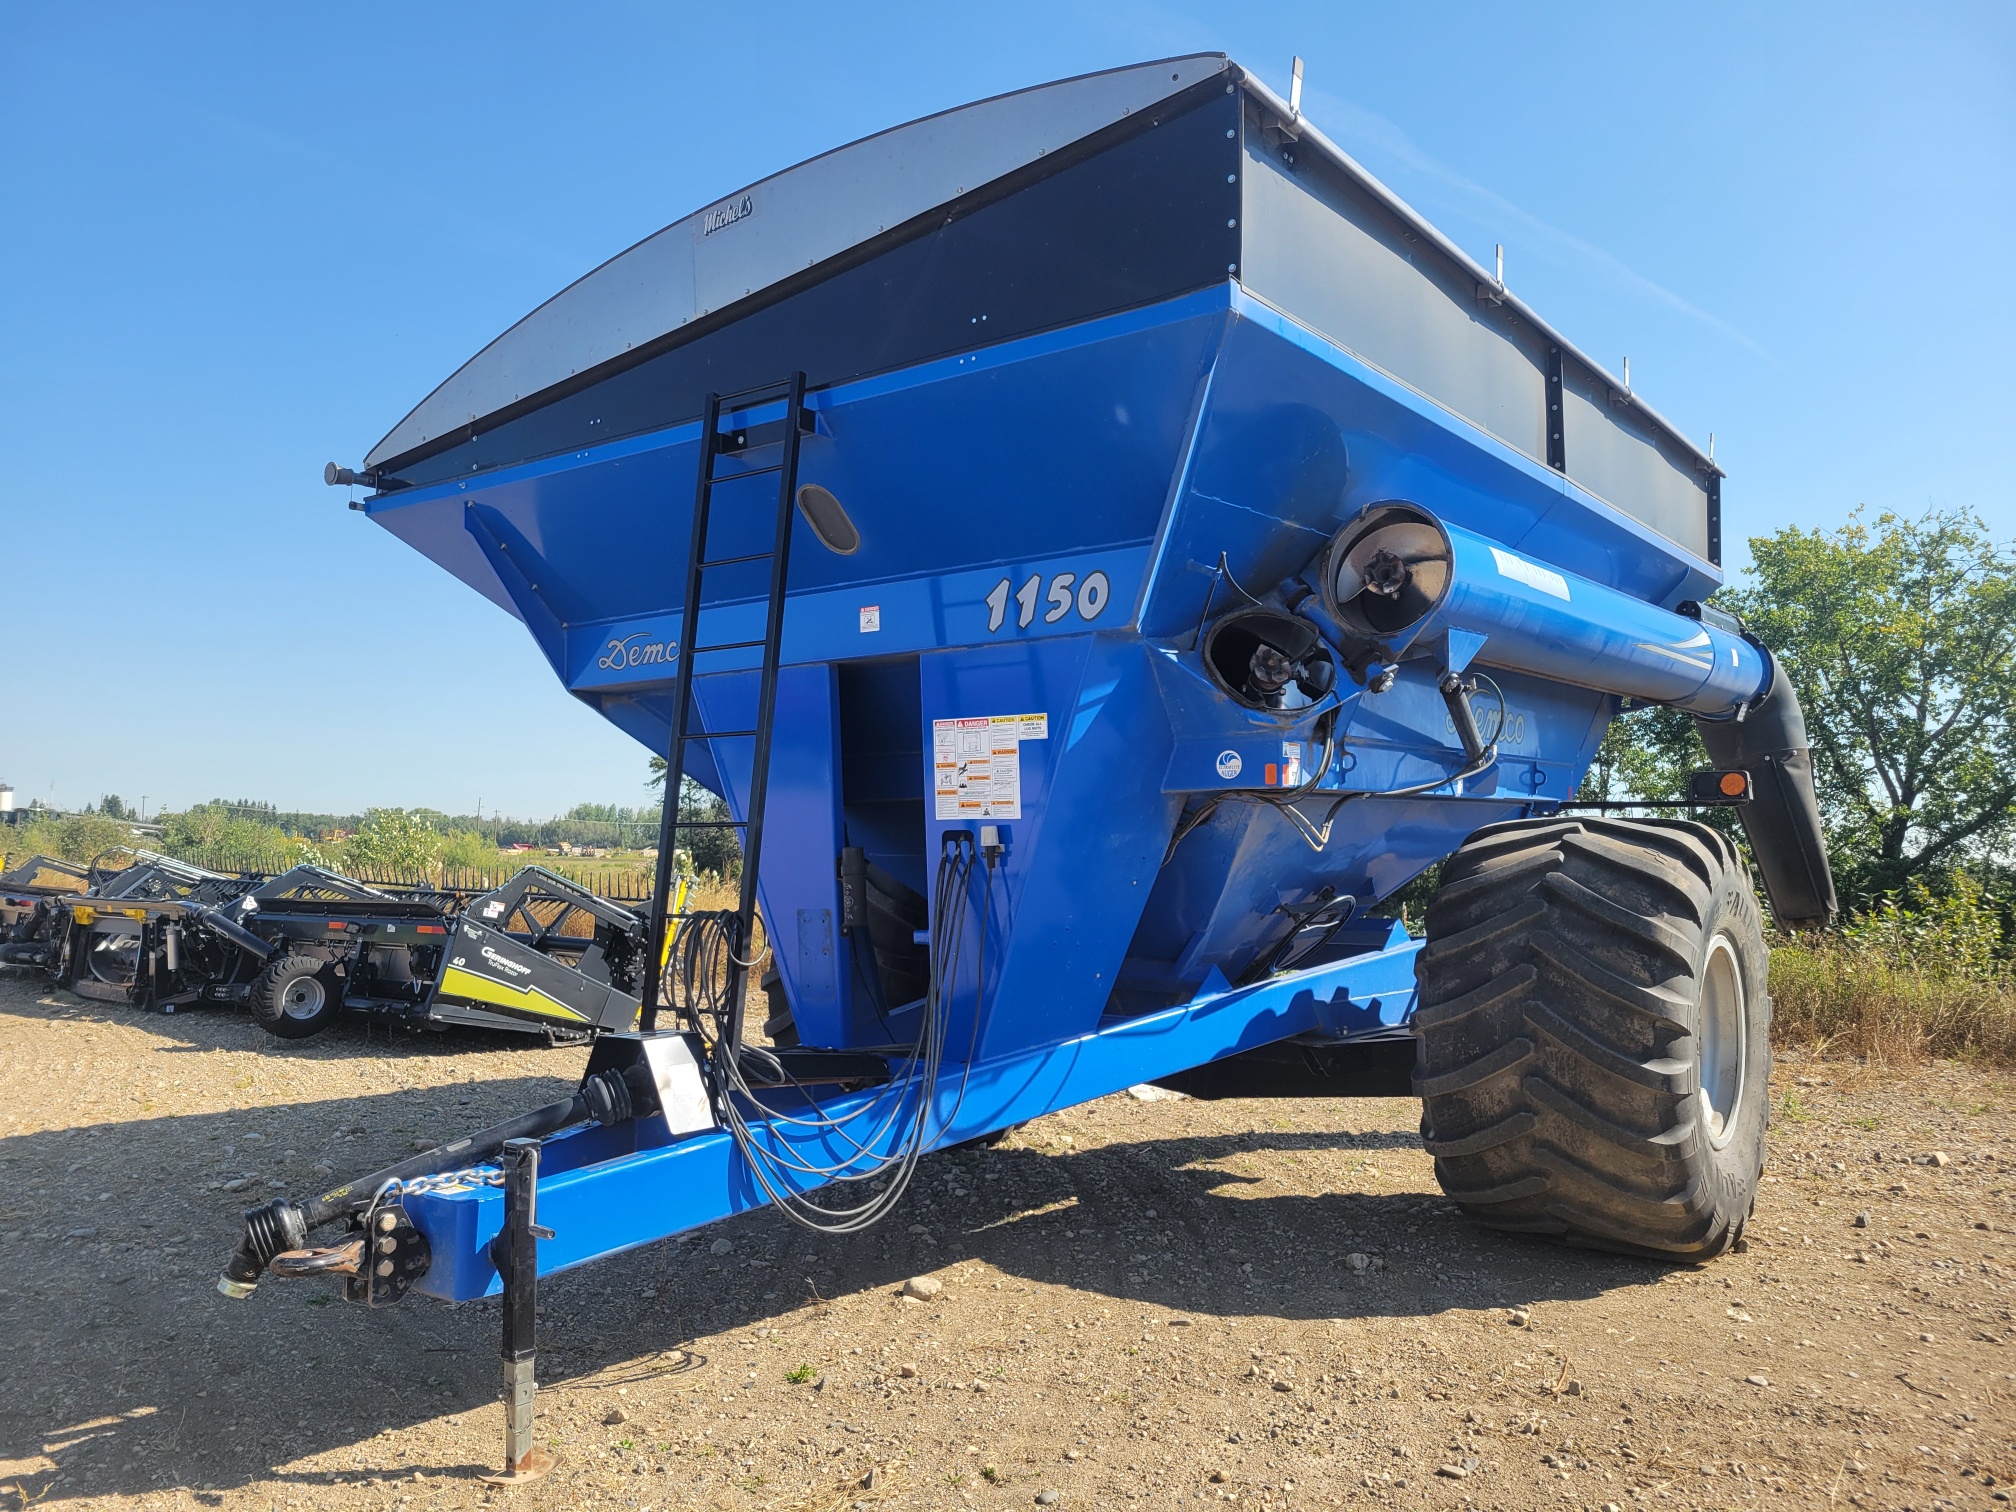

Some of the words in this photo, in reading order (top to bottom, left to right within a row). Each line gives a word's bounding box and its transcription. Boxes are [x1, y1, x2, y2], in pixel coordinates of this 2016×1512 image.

[703, 195, 753, 236] Michel's
[984, 569, 1110, 633] 1150
[598, 631, 681, 671] Demc
[1221, 769, 1238, 778] AUGER
[452, 956, 466, 967] 40
[481, 946, 532, 975] GERINGHOFF
